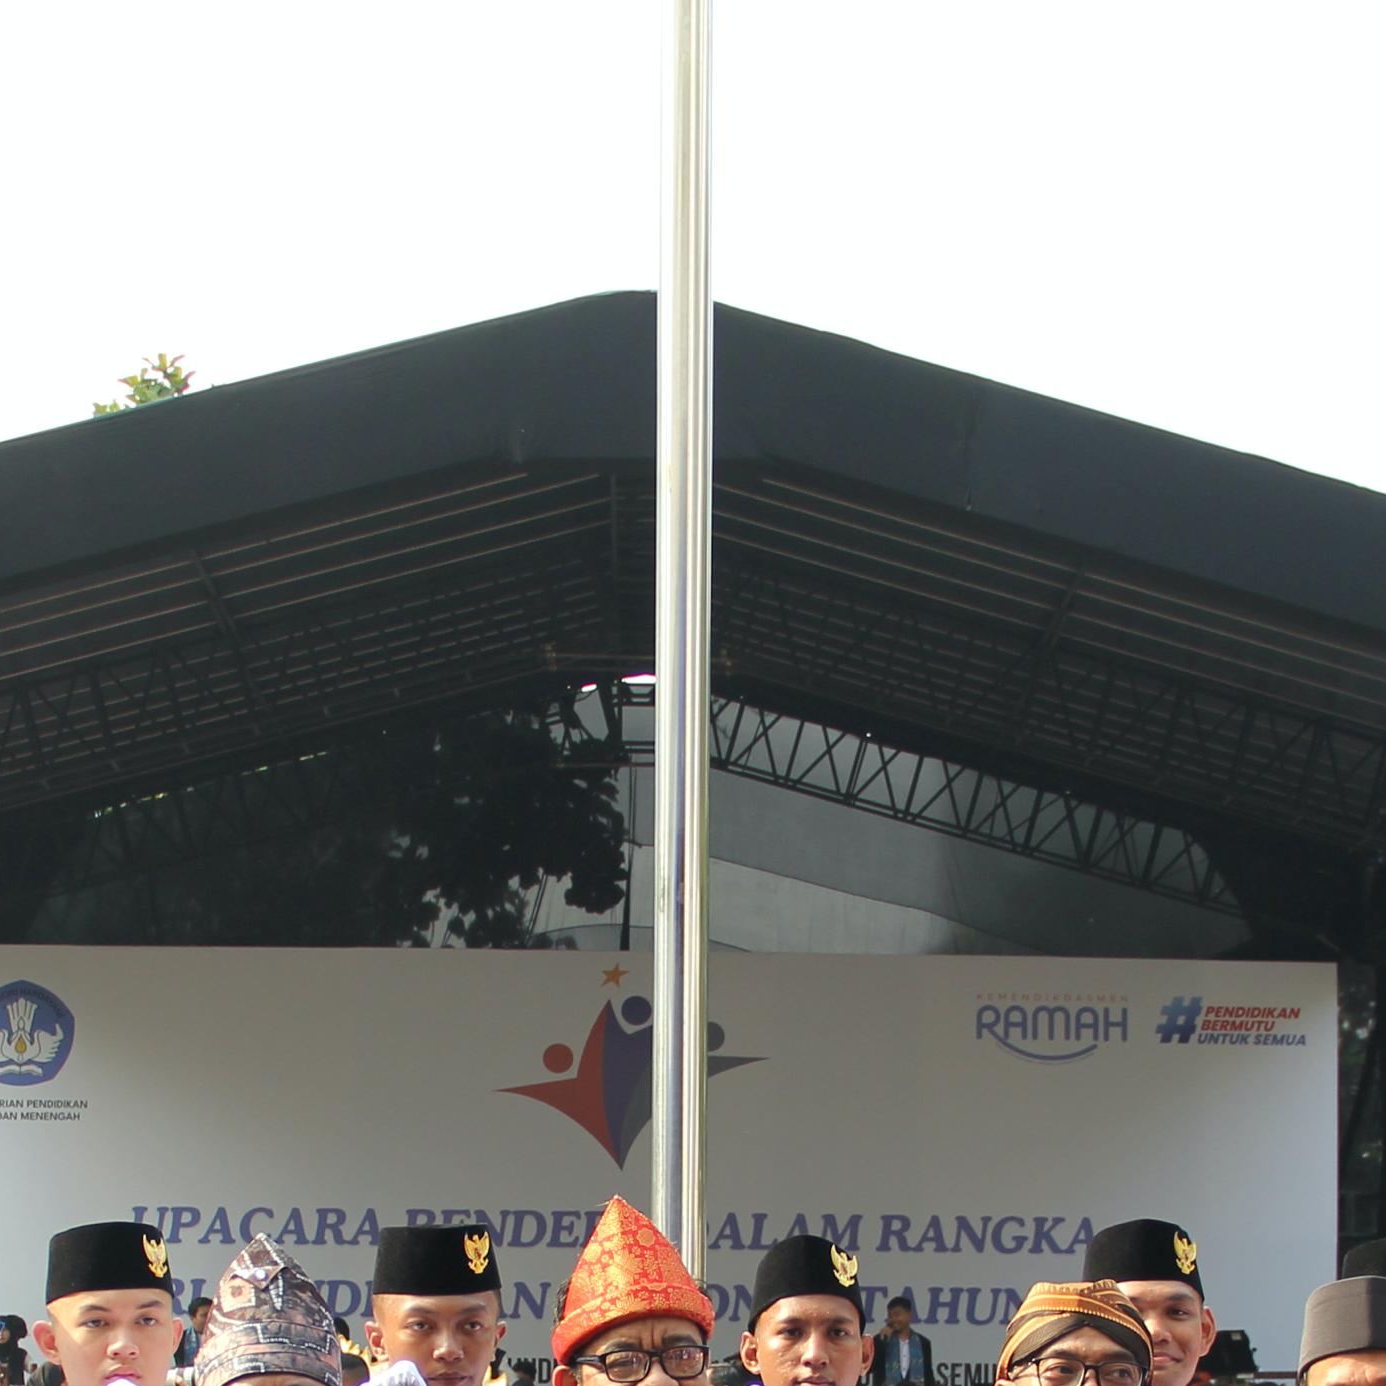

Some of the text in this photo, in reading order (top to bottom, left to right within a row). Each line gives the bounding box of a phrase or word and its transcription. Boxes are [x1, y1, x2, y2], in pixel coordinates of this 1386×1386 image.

[1205, 1006, 1301, 1019] PENDIDIKAN
[976, 1004, 1128, 1044] RAMAH
[1201, 1020, 1276, 1032] BERMUTU
[1197, 1033, 1307, 1047] UNTUK SEMUA
[26, 1099, 88, 1109] PENDIDIKAN
[20, 1112, 81, 1121] MENENGAH
[706, 1212, 863, 1250] ALAM
[875, 1214, 1095, 1254] RANGKA
